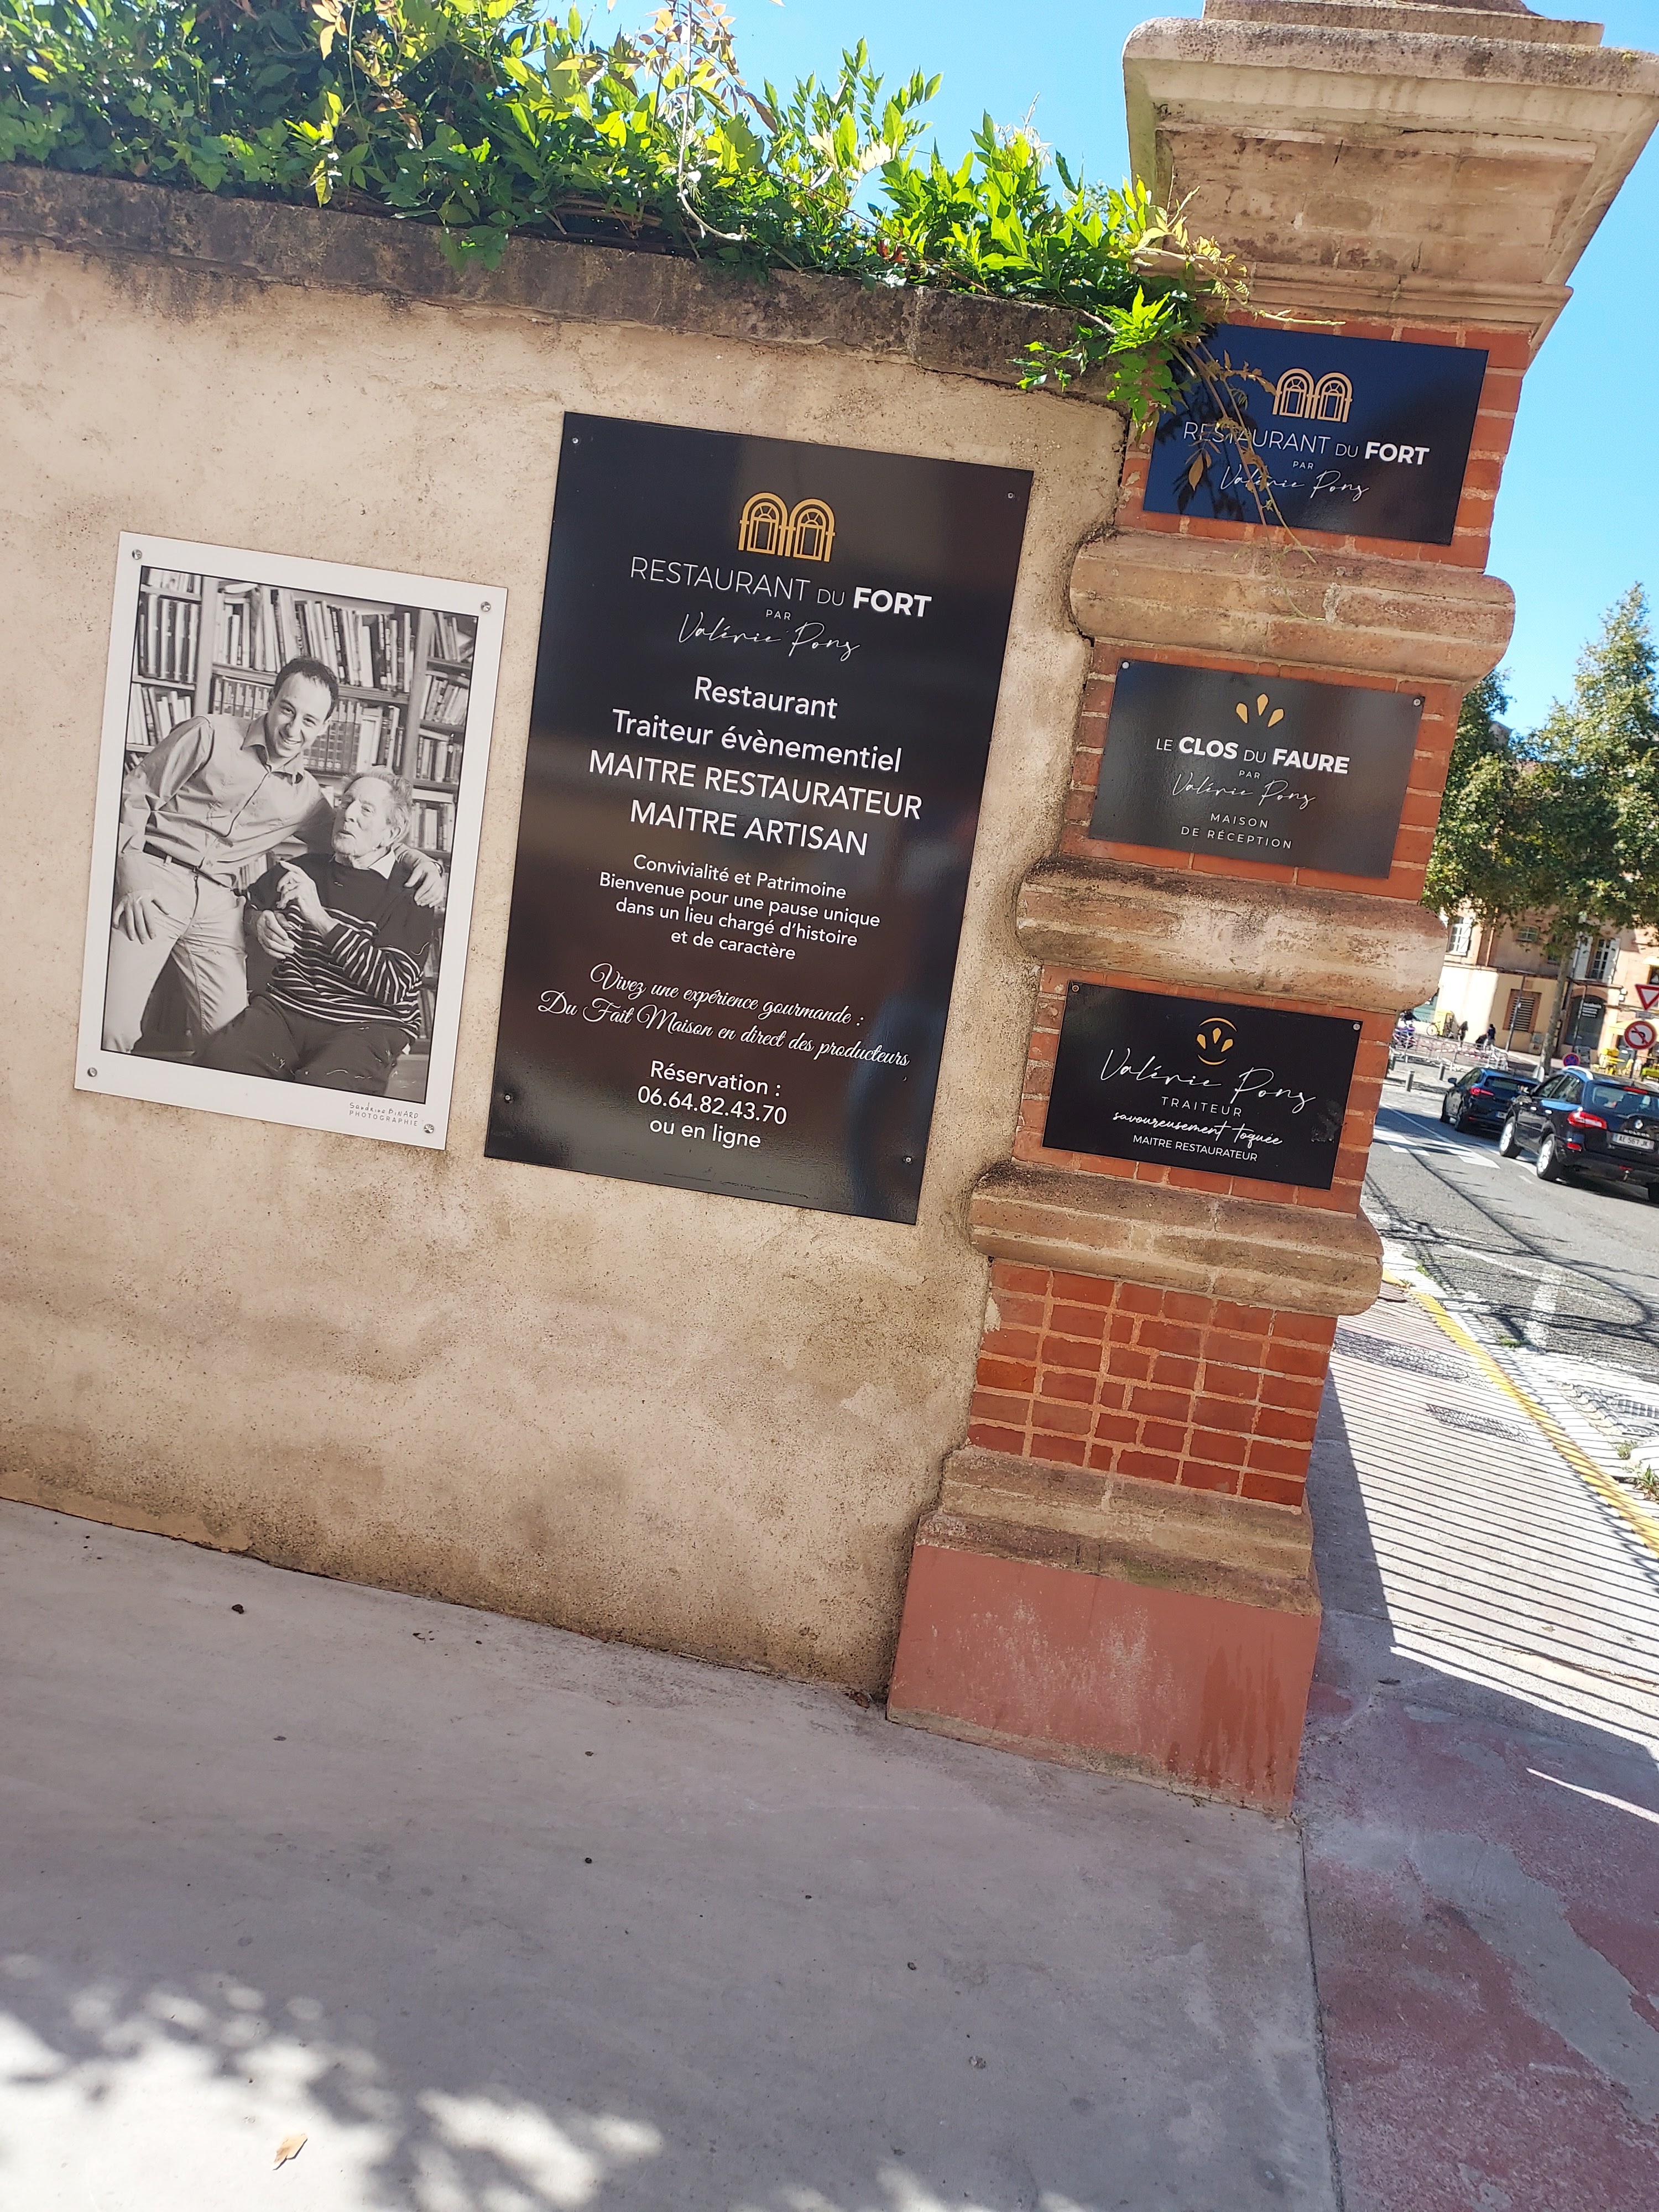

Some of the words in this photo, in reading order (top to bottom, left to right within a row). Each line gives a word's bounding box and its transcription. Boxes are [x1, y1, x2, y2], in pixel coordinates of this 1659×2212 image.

[1292, 461, 1313, 469] PAR
[1335, 444, 1359, 457] DU
[1365, 441, 1430, 465] FORT
[630, 556, 811, 601] RESTAURANT
[817, 588, 845, 606] DU
[853, 587, 932, 617] FORT
[679, 611, 781, 643] Valérie
[766, 609, 791, 620] PAR
[695, 676, 838, 719] Restaurant
[612, 708, 713, 745] Traiteur
[721, 726, 902, 772] évènementiel
[1156, 738, 1173, 752] LE
[1179, 737, 1239, 759] CLOS
[1244, 749, 1266, 763] DU
[1272, 748, 1350, 774] FAURE
[589, 749, 696, 787] MAITRE
[705, 766, 922, 820] RESTAURATEUR
[1172, 771, 1254, 796] Valérie
[1239, 770, 1260, 779] PAR
[630, 800, 737, 837] MAITRE
[743, 817, 868, 855] ARTISAN
[1181, 826, 1199, 837] DE
[1207, 830, 1291, 849] RÉCEPTION
[1211, 813, 1268, 828] MAISON
[634, 854, 729, 881] Convivialité
[734, 872, 752, 885] et
[757, 872, 846, 899] Patrimoine
[599, 872, 685, 898] Bienvenue
[689, 889, 729, 905] pour
[734, 896, 764, 910] une
[768, 901, 818, 917] pause
[824, 907, 880, 928] unique
[616, 897, 654, 916] dans
[660, 907, 679, 920] un
[685, 906, 713, 925] lieu
[718, 912, 775, 937] chargé
[671, 931, 688, 944] et
[693, 931, 714, 948] de
[719, 940, 795, 959] caractère
[590, 963, 646, 1000] Vivez
[650, 984, 679, 998] une
[683, 989, 759, 1010] expérience
[758, 1001, 852, 1024] gourmande
[538, 990, 578, 1015] Du
[582, 998, 635, 1024] Fait
[637, 1004, 714, 1036] Maison
[718, 1028, 737, 1040] en
[740, 1025, 787, 1047] direct
[788, 1032, 815, 1052] des
[813, 1041, 910, 1066] producteurs
[650, 1060, 768, 1095] Réservation
[1100, 1047, 1222, 1087] Valérie
[349, 1110, 418, 1126] PHOTOGRAPHIE
[638, 1084, 787, 1124] 06.64.82.43.70
[1161, 1096, 1241, 1117] TRAITEUR
[650, 1120, 675, 1135] ou
[681, 1125, 705, 1140] en
[712, 1123, 761, 1149] ligne
[1113, 1112, 1232, 1141] savoureusement
[1232, 1123, 1283, 1149] toquée
[1133, 1135, 1173, 1149] MAITRE
[1175, 1141, 1258, 1162] RESTAURATEUR
